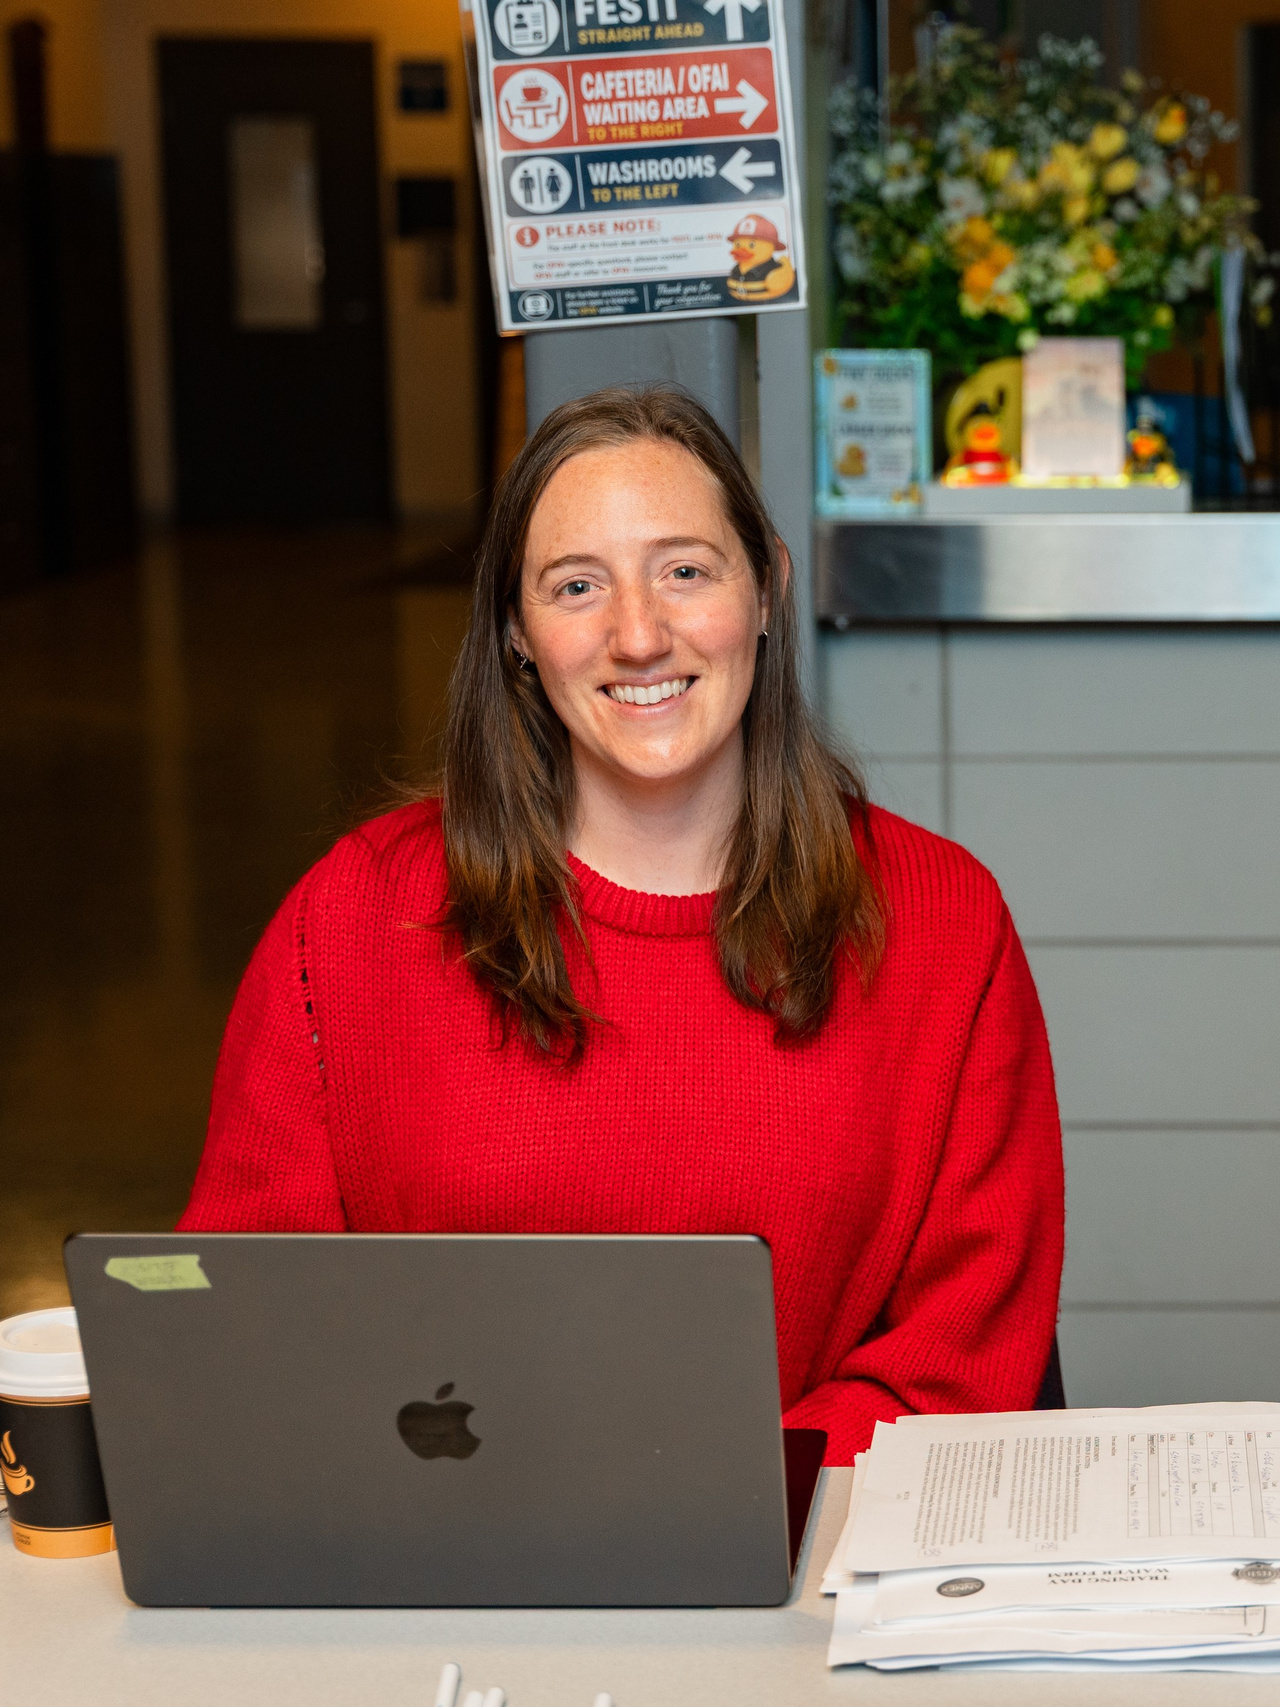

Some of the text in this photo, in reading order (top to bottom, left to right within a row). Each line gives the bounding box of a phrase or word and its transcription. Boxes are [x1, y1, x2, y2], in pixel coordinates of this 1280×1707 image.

[574, 0, 678, 27] FESTI
[577, 22, 705, 45] STRAIGHT AHEAD
[580, 67, 676, 100] CAFETERIA
[688, 63, 729, 93] OFAI
[583, 96, 710, 126] WAITING AREA
[587, 121, 684, 141] TO THE RIGHT
[587, 154, 717, 185] WASHROOMS
[591, 183, 679, 203] TO THE LEFT
[546, 222, 606, 238] PLEASE
